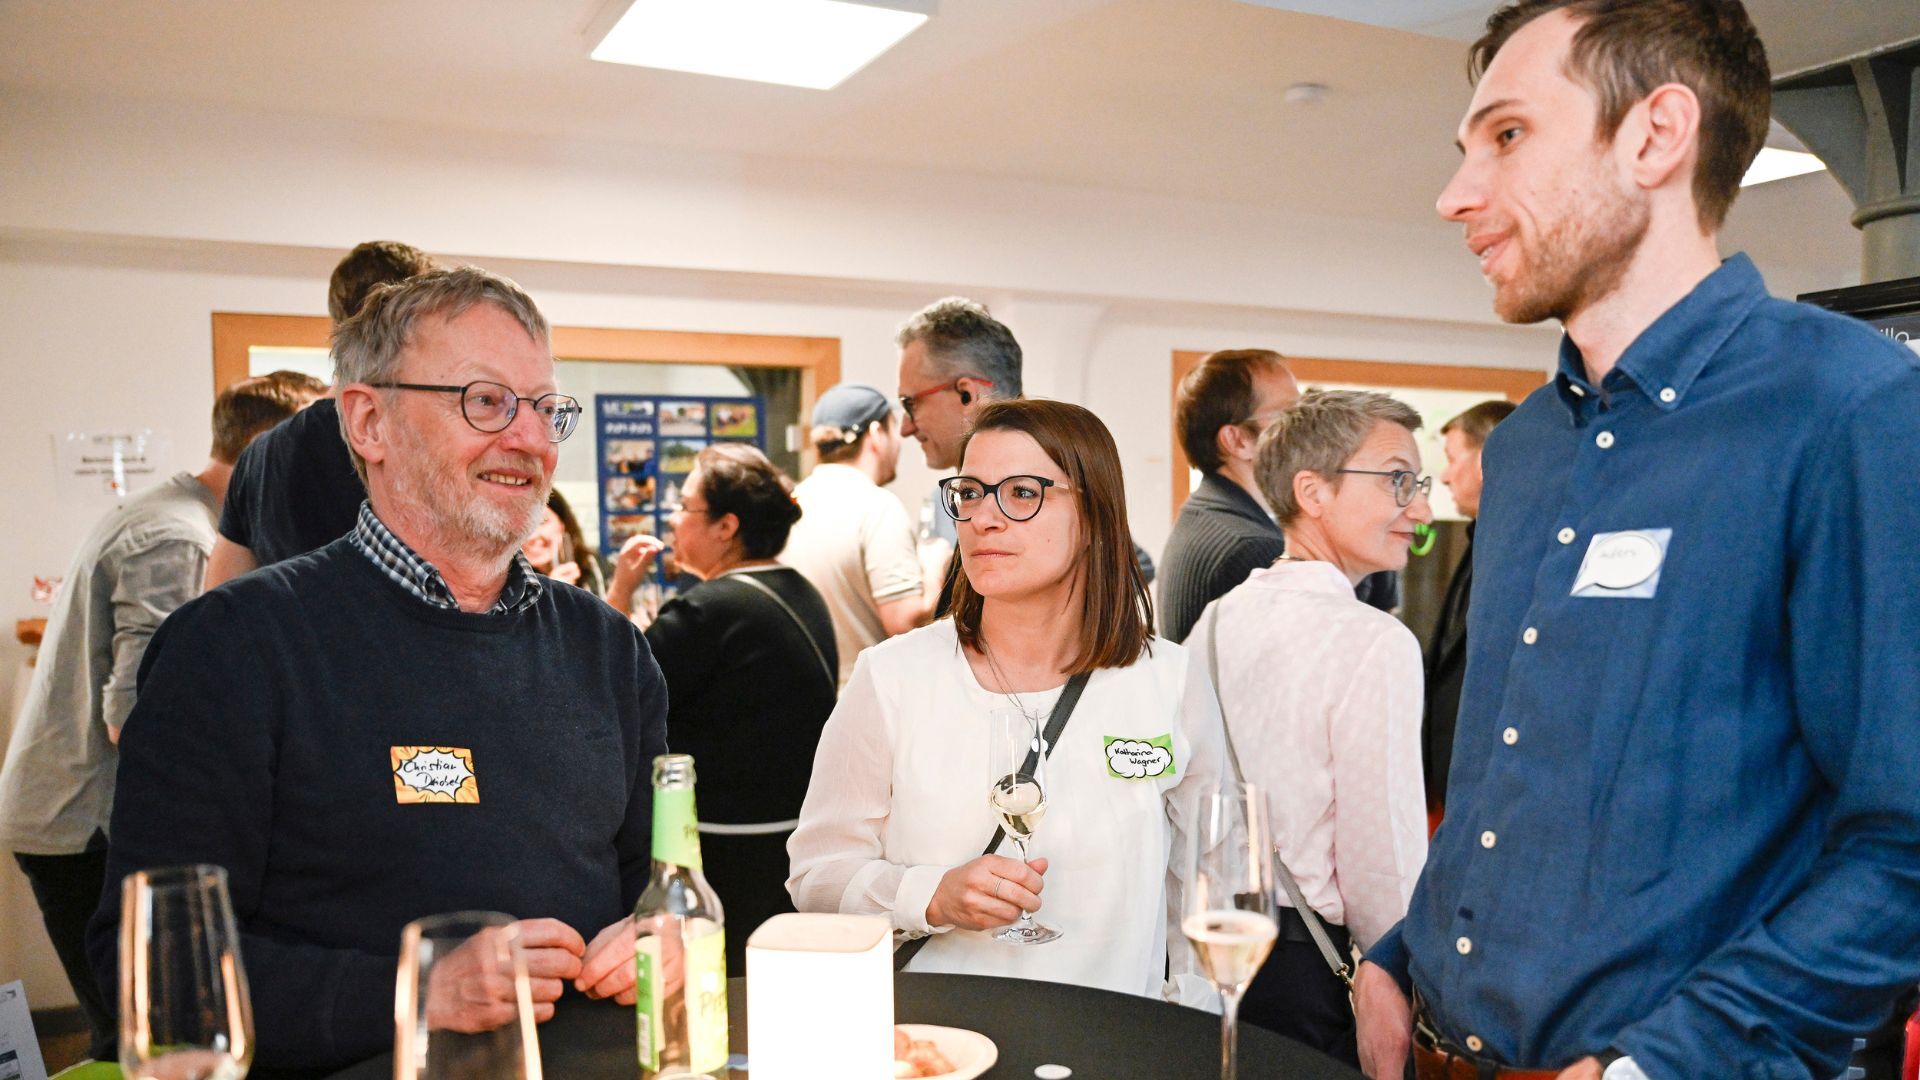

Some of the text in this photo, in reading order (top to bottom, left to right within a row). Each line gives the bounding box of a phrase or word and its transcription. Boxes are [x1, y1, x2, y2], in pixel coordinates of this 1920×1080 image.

[1114, 747, 1153, 757] Katharina
[403, 758, 457, 774] Christian
[1129, 756, 1162, 767] Wagner
